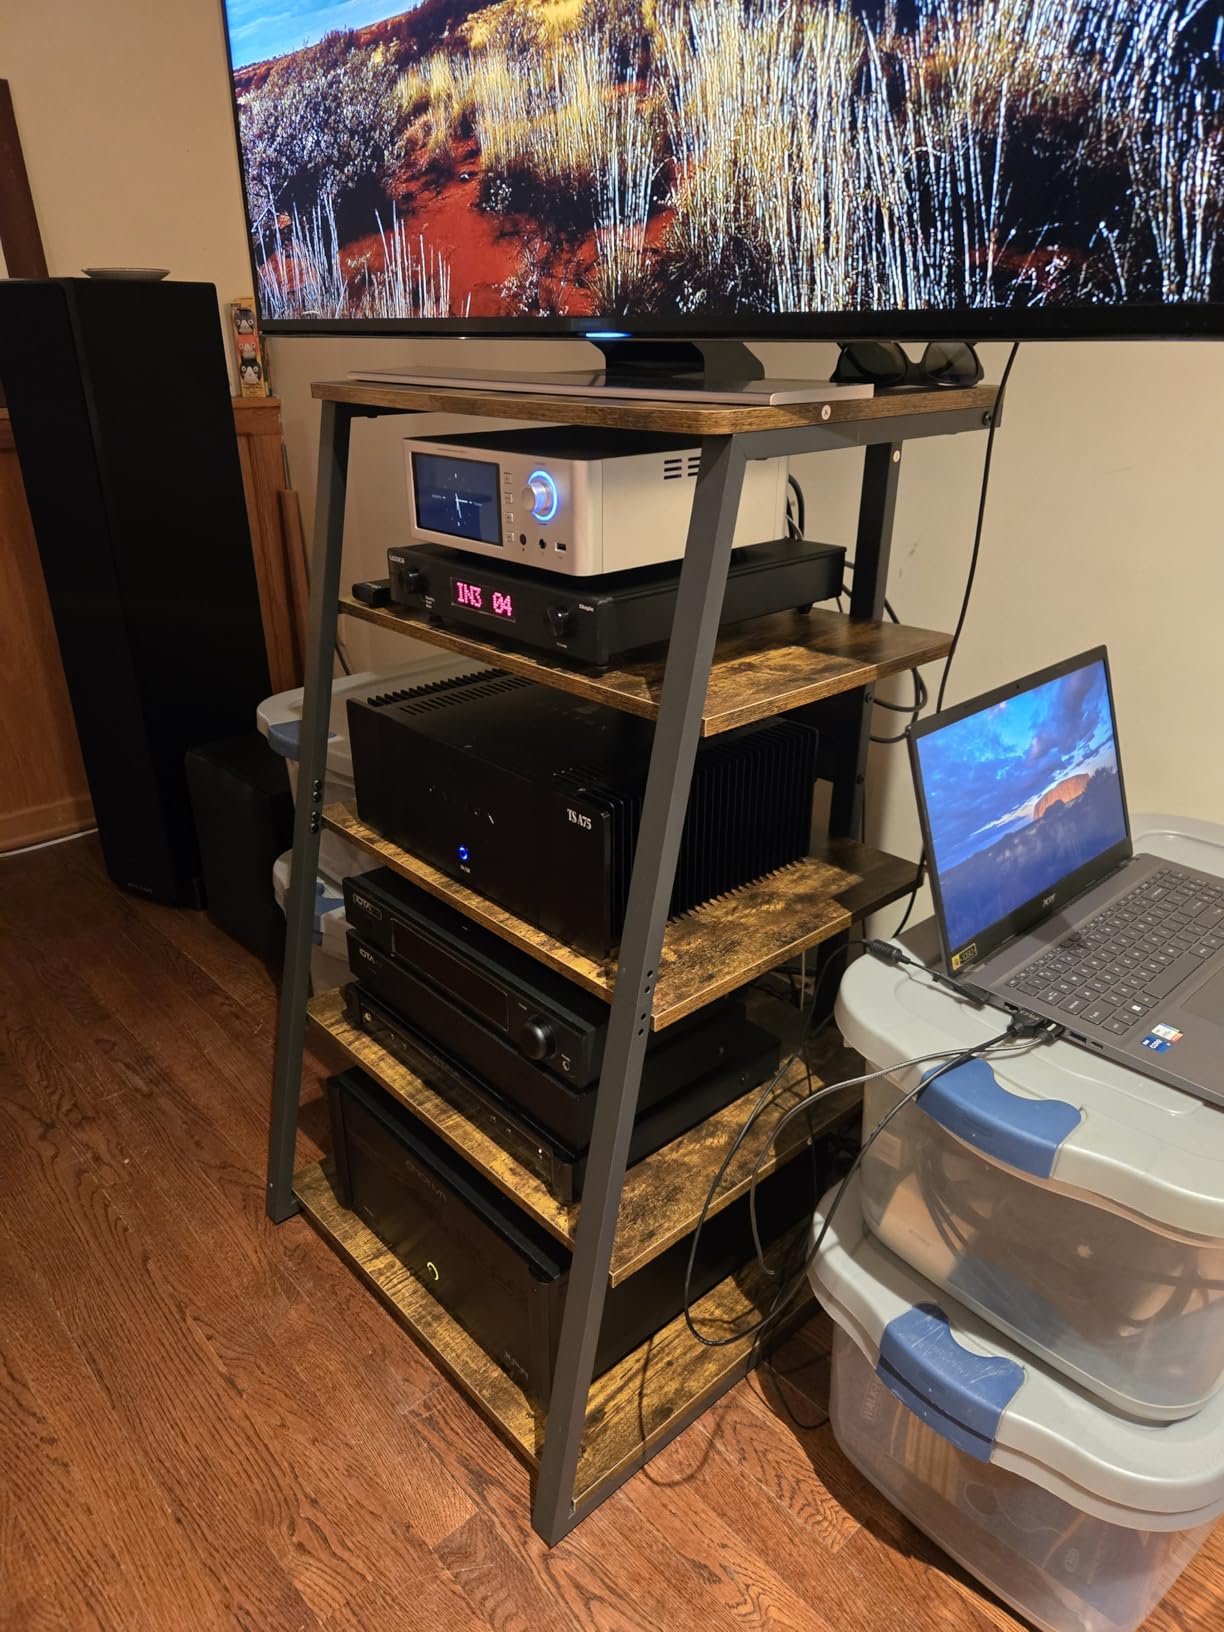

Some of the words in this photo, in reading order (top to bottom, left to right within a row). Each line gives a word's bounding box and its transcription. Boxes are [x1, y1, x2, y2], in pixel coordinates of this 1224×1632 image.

[456, 581, 482, 608] IN3
[492, 592, 513, 617] 04
[566, 808, 577, 823] TS
[577, 813, 592, 830] A75
[360, 948, 376, 965] IOTA
